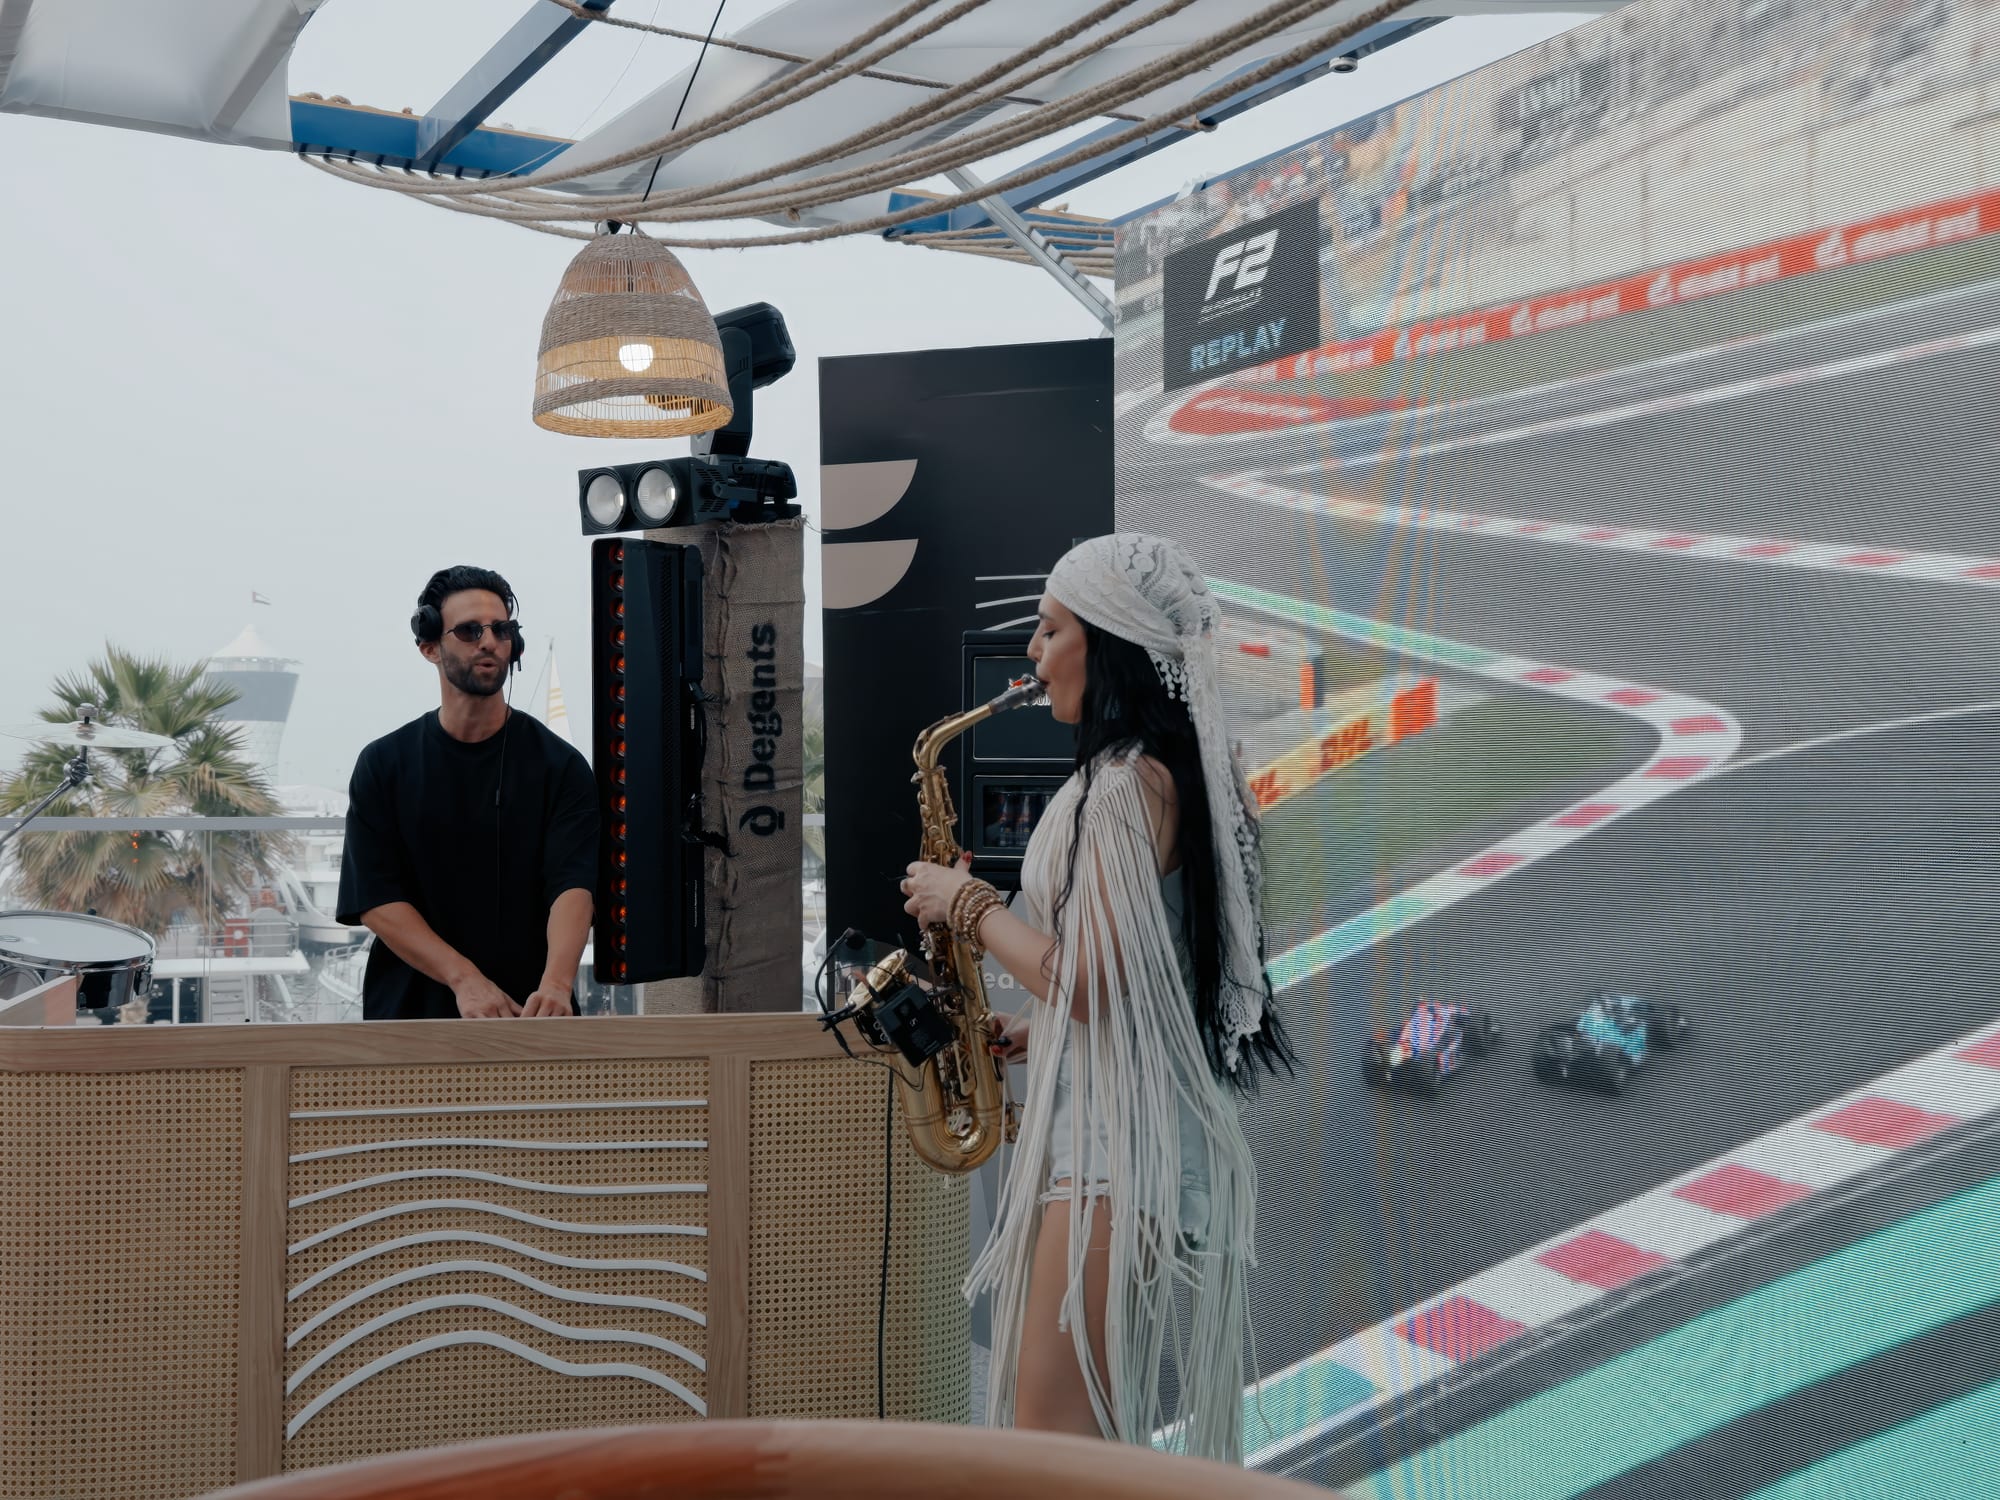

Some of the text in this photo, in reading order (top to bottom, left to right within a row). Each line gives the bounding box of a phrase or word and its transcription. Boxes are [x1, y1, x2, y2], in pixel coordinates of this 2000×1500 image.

[1205, 229, 1278, 300] F2
[1190, 319, 1286, 371] REPLAY
[743, 621, 783, 791] Degents
[1321, 718, 1373, 772] DHL
